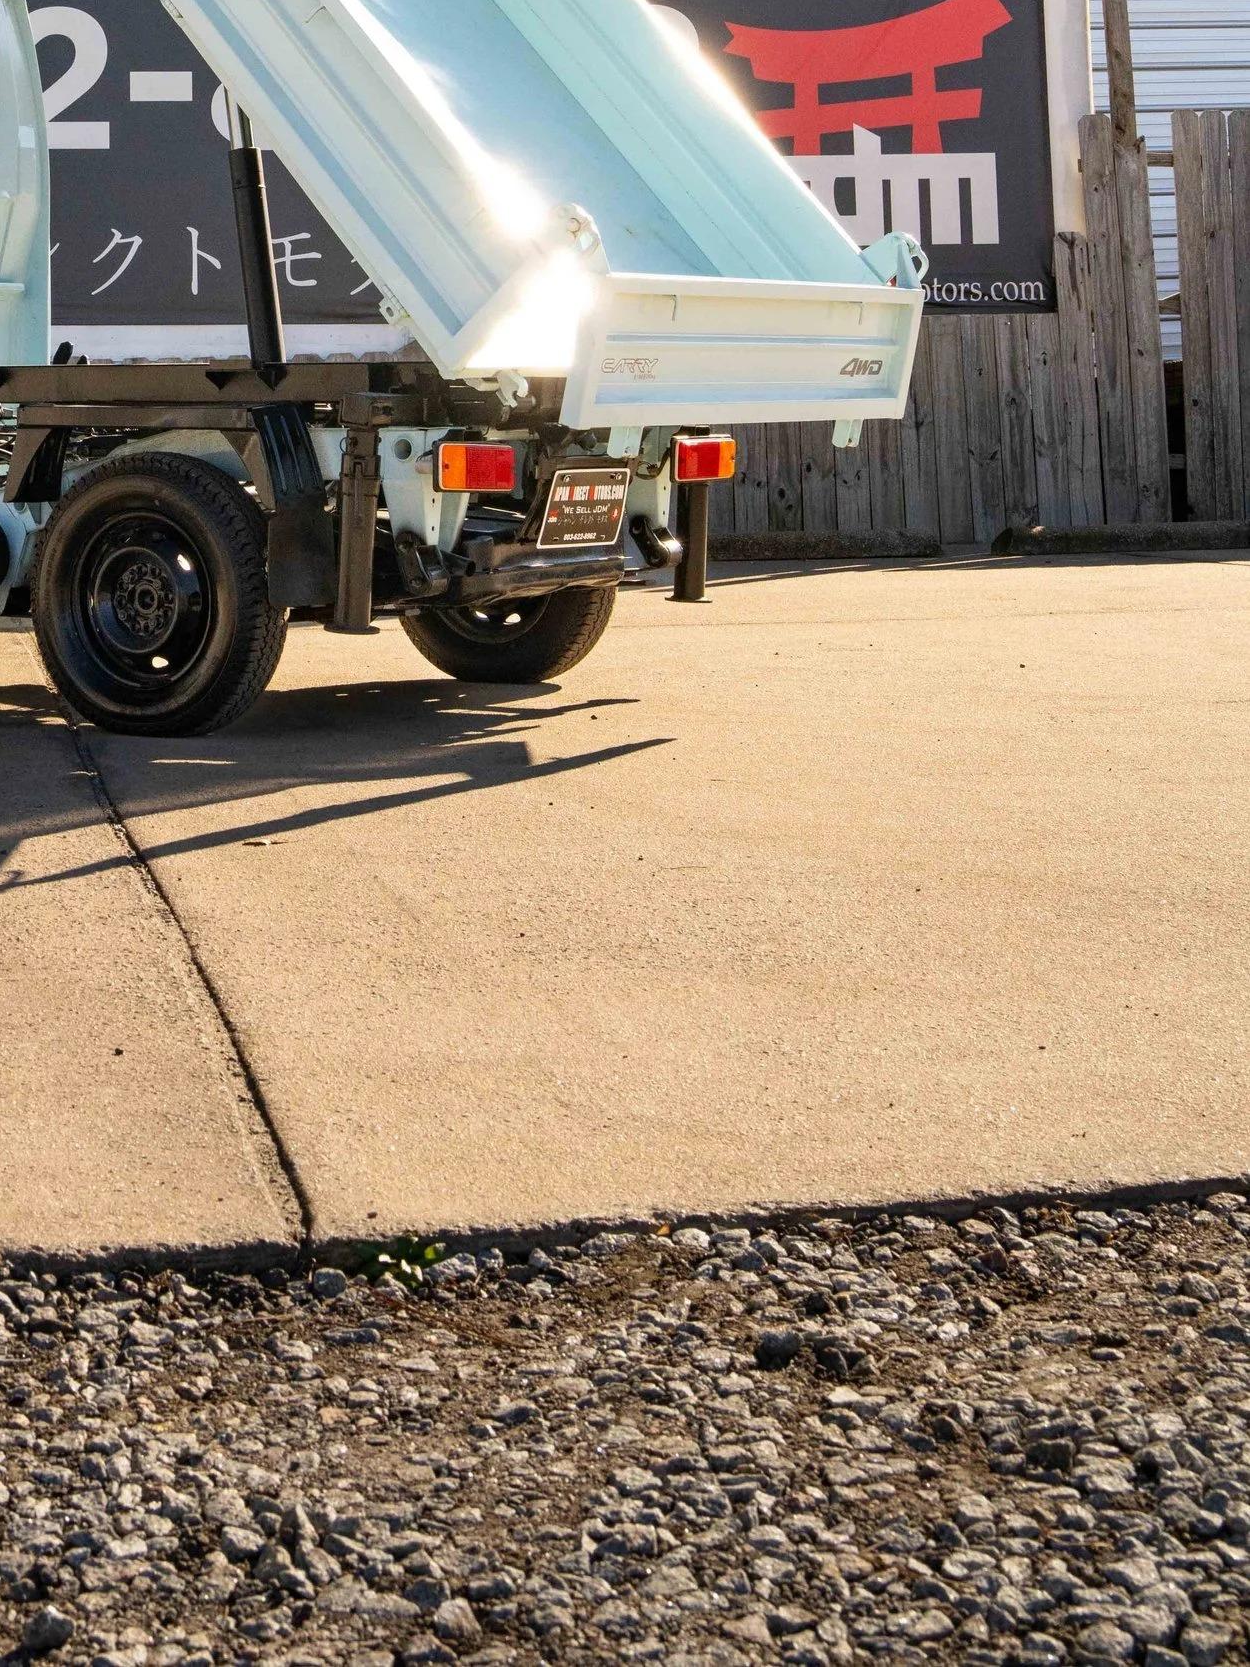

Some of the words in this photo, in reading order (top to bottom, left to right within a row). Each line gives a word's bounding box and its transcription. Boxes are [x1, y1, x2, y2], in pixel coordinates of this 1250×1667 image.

[50, 226, 374, 295] クトモ
[601, 358, 659, 374] CARRY
[839, 357, 883, 377] 4WD
